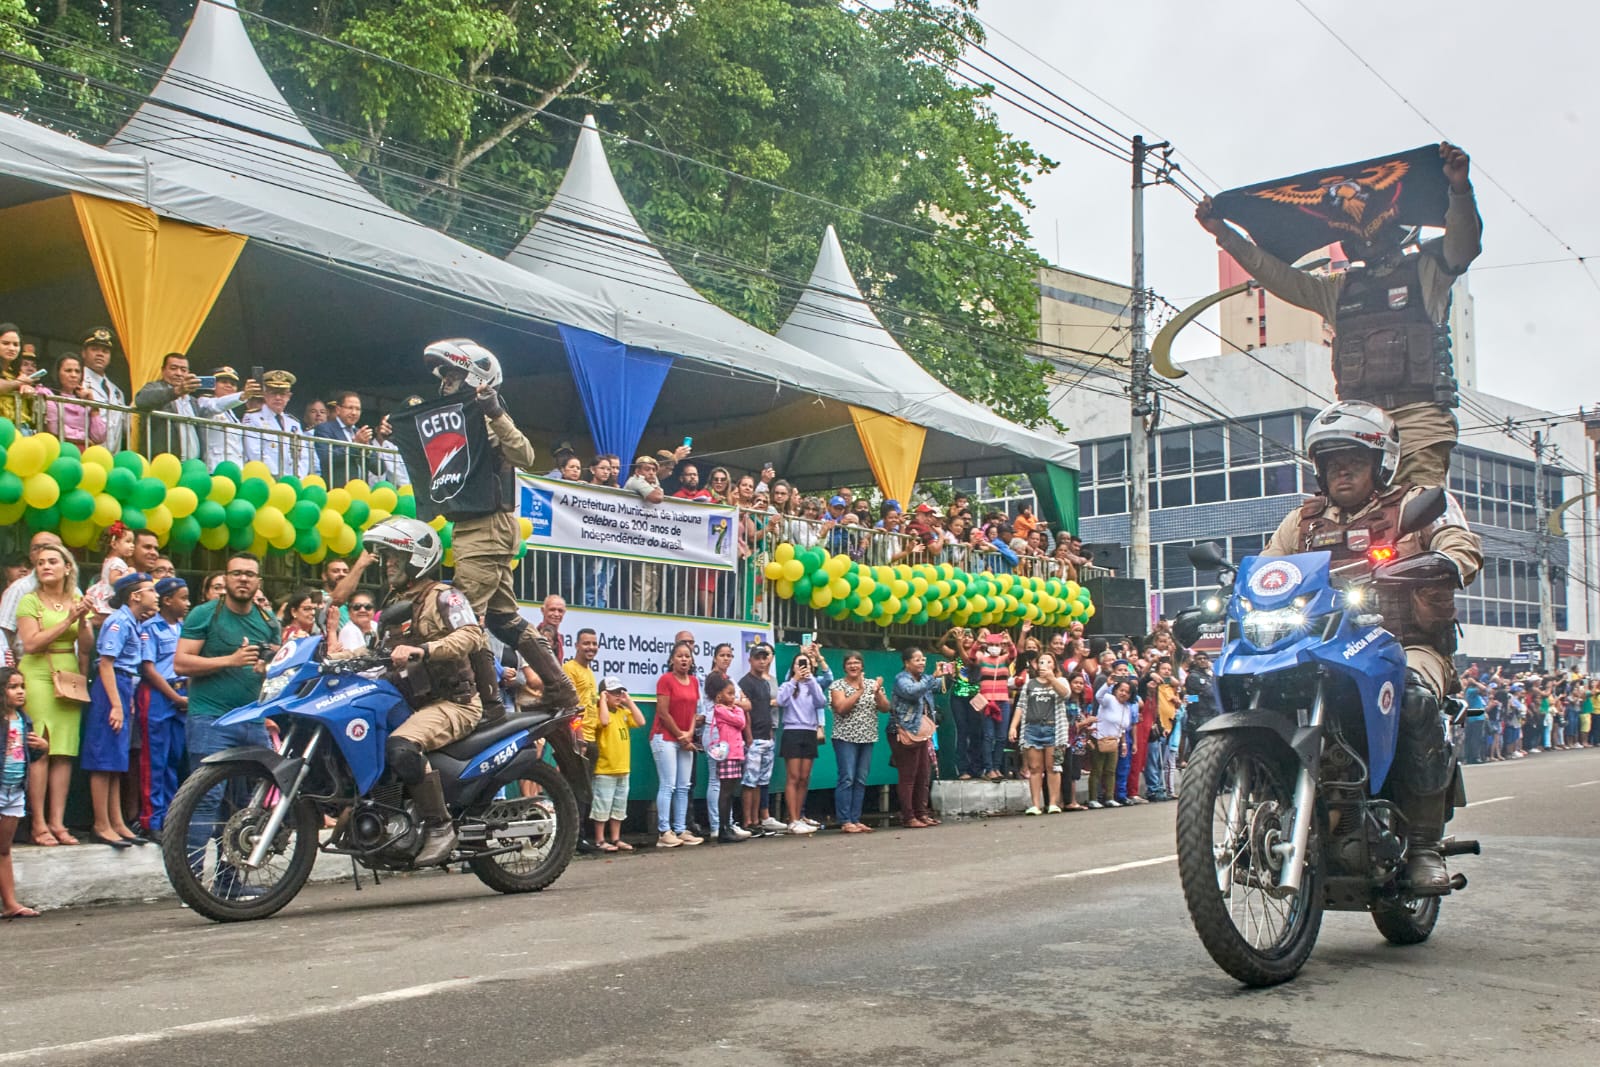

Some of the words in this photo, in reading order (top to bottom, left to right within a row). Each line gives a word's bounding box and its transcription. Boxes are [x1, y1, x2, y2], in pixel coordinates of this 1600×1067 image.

[421, 411, 462, 438] CETO
[559, 494, 569, 507] A
[571, 495, 616, 513] Prefeitura
[617, 502, 659, 520] Municipal
[660, 509, 672, 521] de
[582, 514, 618, 529] celebra
[620, 520, 630, 530] os
[631, 518, 648, 532] 200
[650, 523, 670, 535] anos
[670, 524, 682, 537] de
[581, 527, 646, 547] Independência
[646, 536, 660, 548] do
[597, 632, 626, 652] Arte
[629, 634, 676, 655] Modern
[603, 660, 625, 677] por
[628, 658, 659, 675] meio
[479, 740, 519, 773] 8.1541
